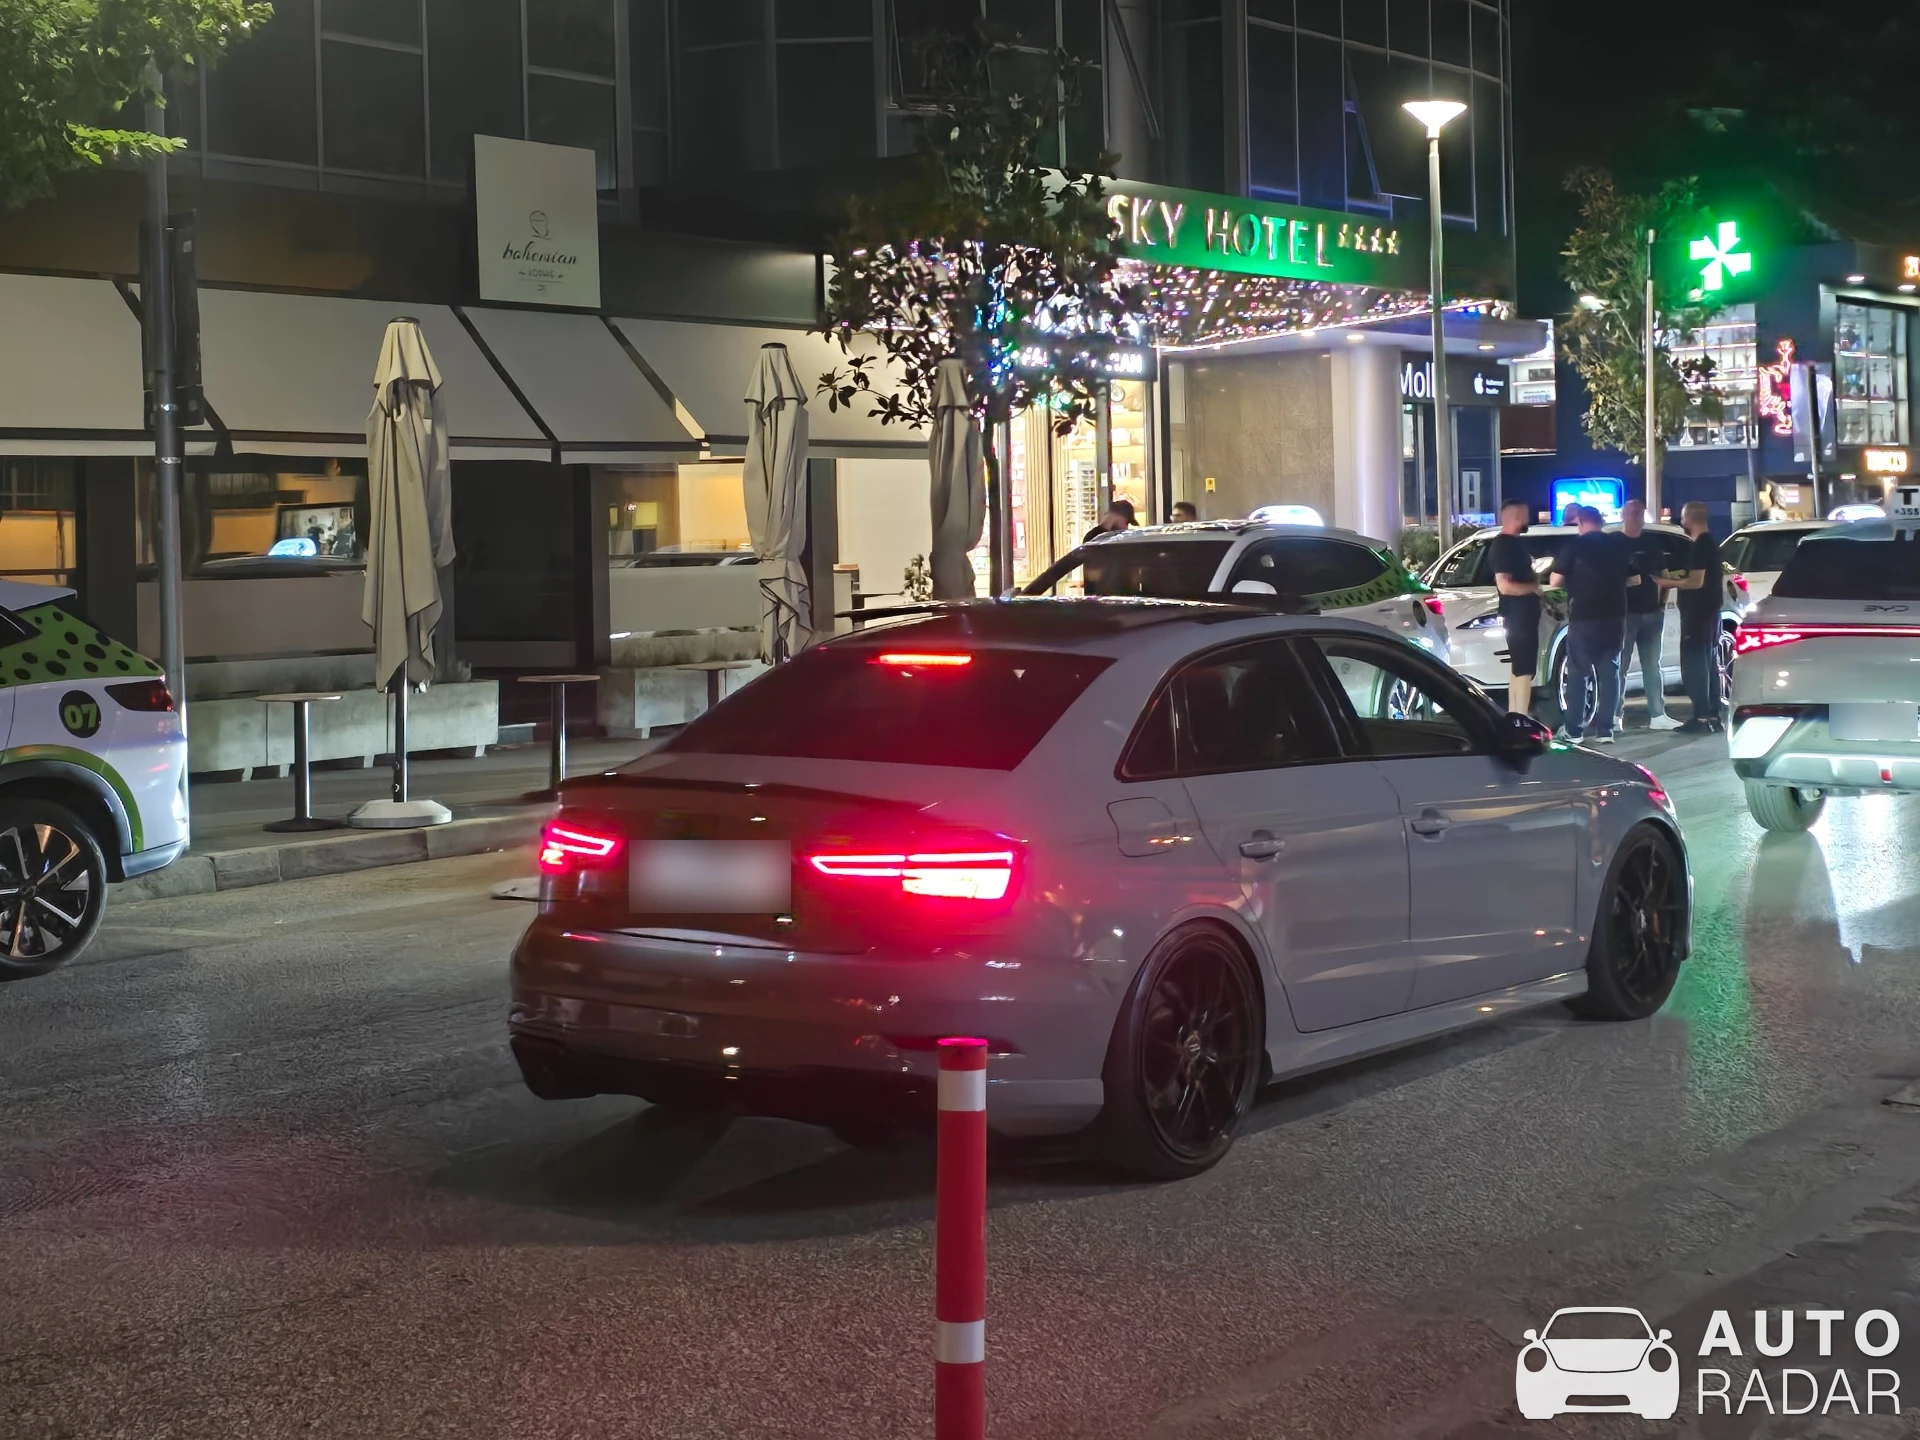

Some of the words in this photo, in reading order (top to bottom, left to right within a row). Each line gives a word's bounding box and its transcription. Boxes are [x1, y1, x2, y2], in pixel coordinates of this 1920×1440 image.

[1106, 194, 1185, 248] SKY
[1205, 208, 1335, 267] HOTEL
[1863, 604, 1910, 613] BYD
[64, 703, 98, 730] 07
